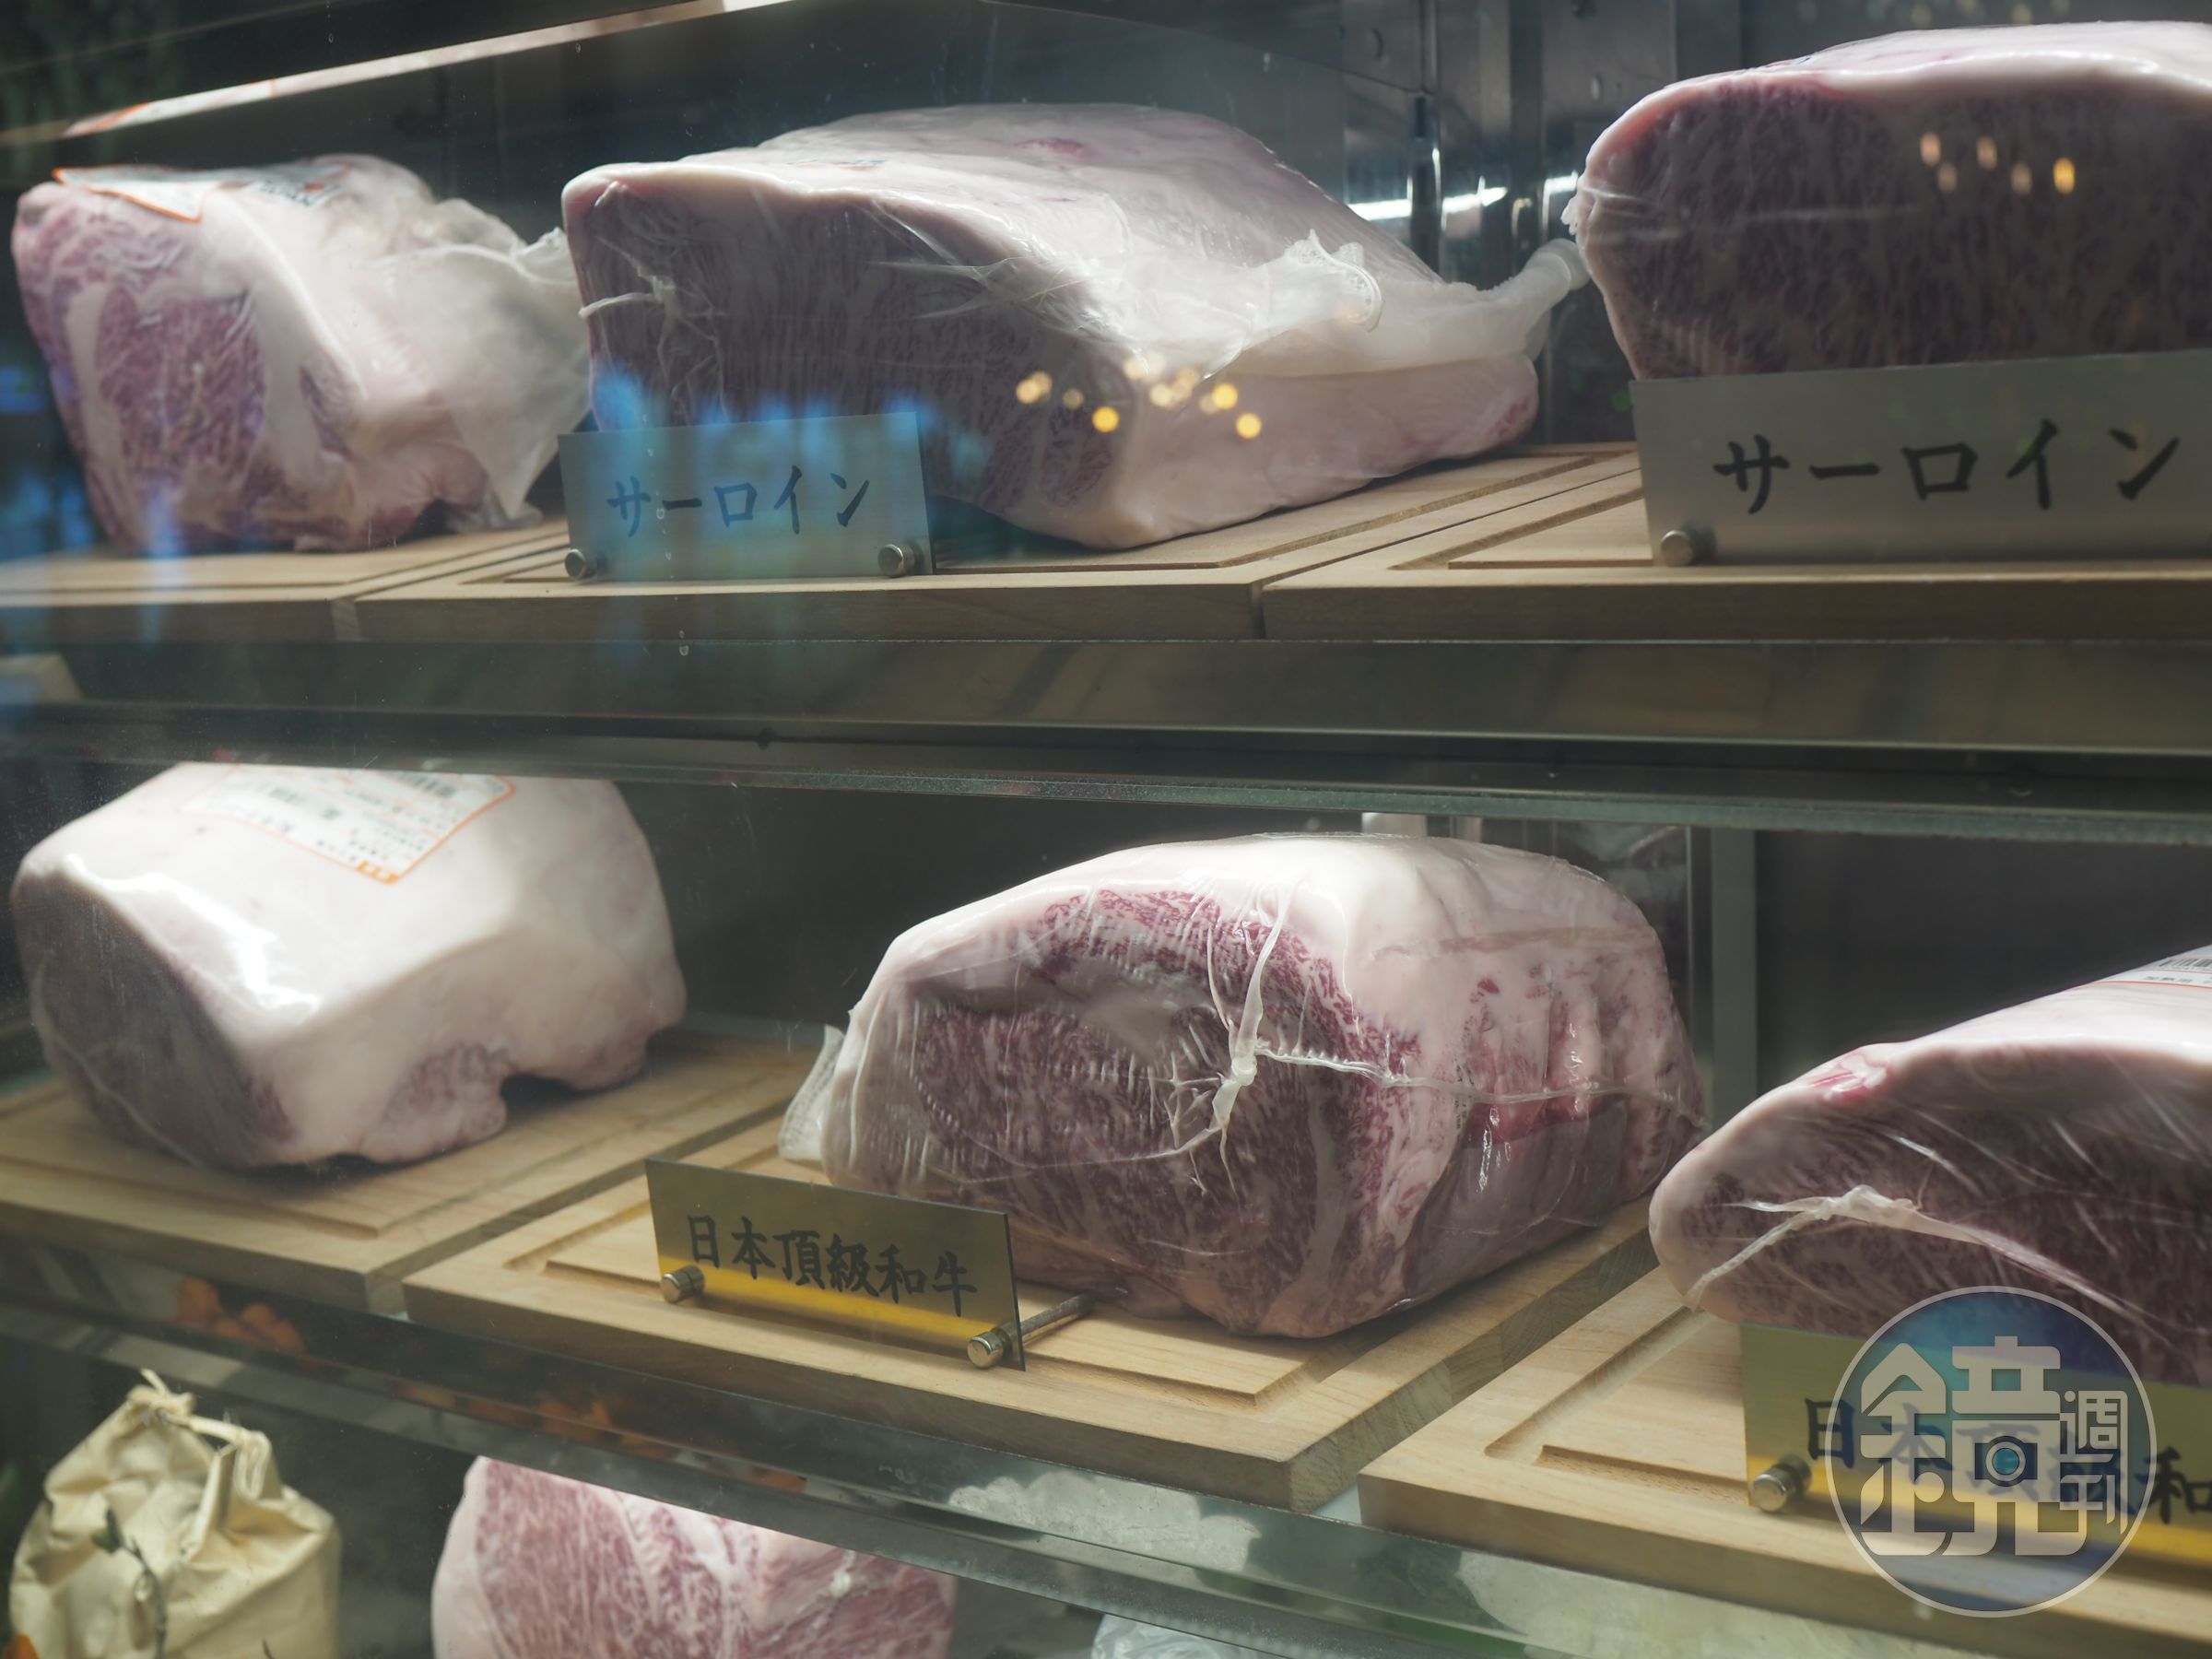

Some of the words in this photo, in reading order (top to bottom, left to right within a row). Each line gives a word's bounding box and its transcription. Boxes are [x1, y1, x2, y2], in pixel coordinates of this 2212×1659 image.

[606, 465, 870, 537] サーロイン
[1712, 418, 2180, 514] サーロイン
[687, 1214, 978, 1318] 日本頂級和牛
